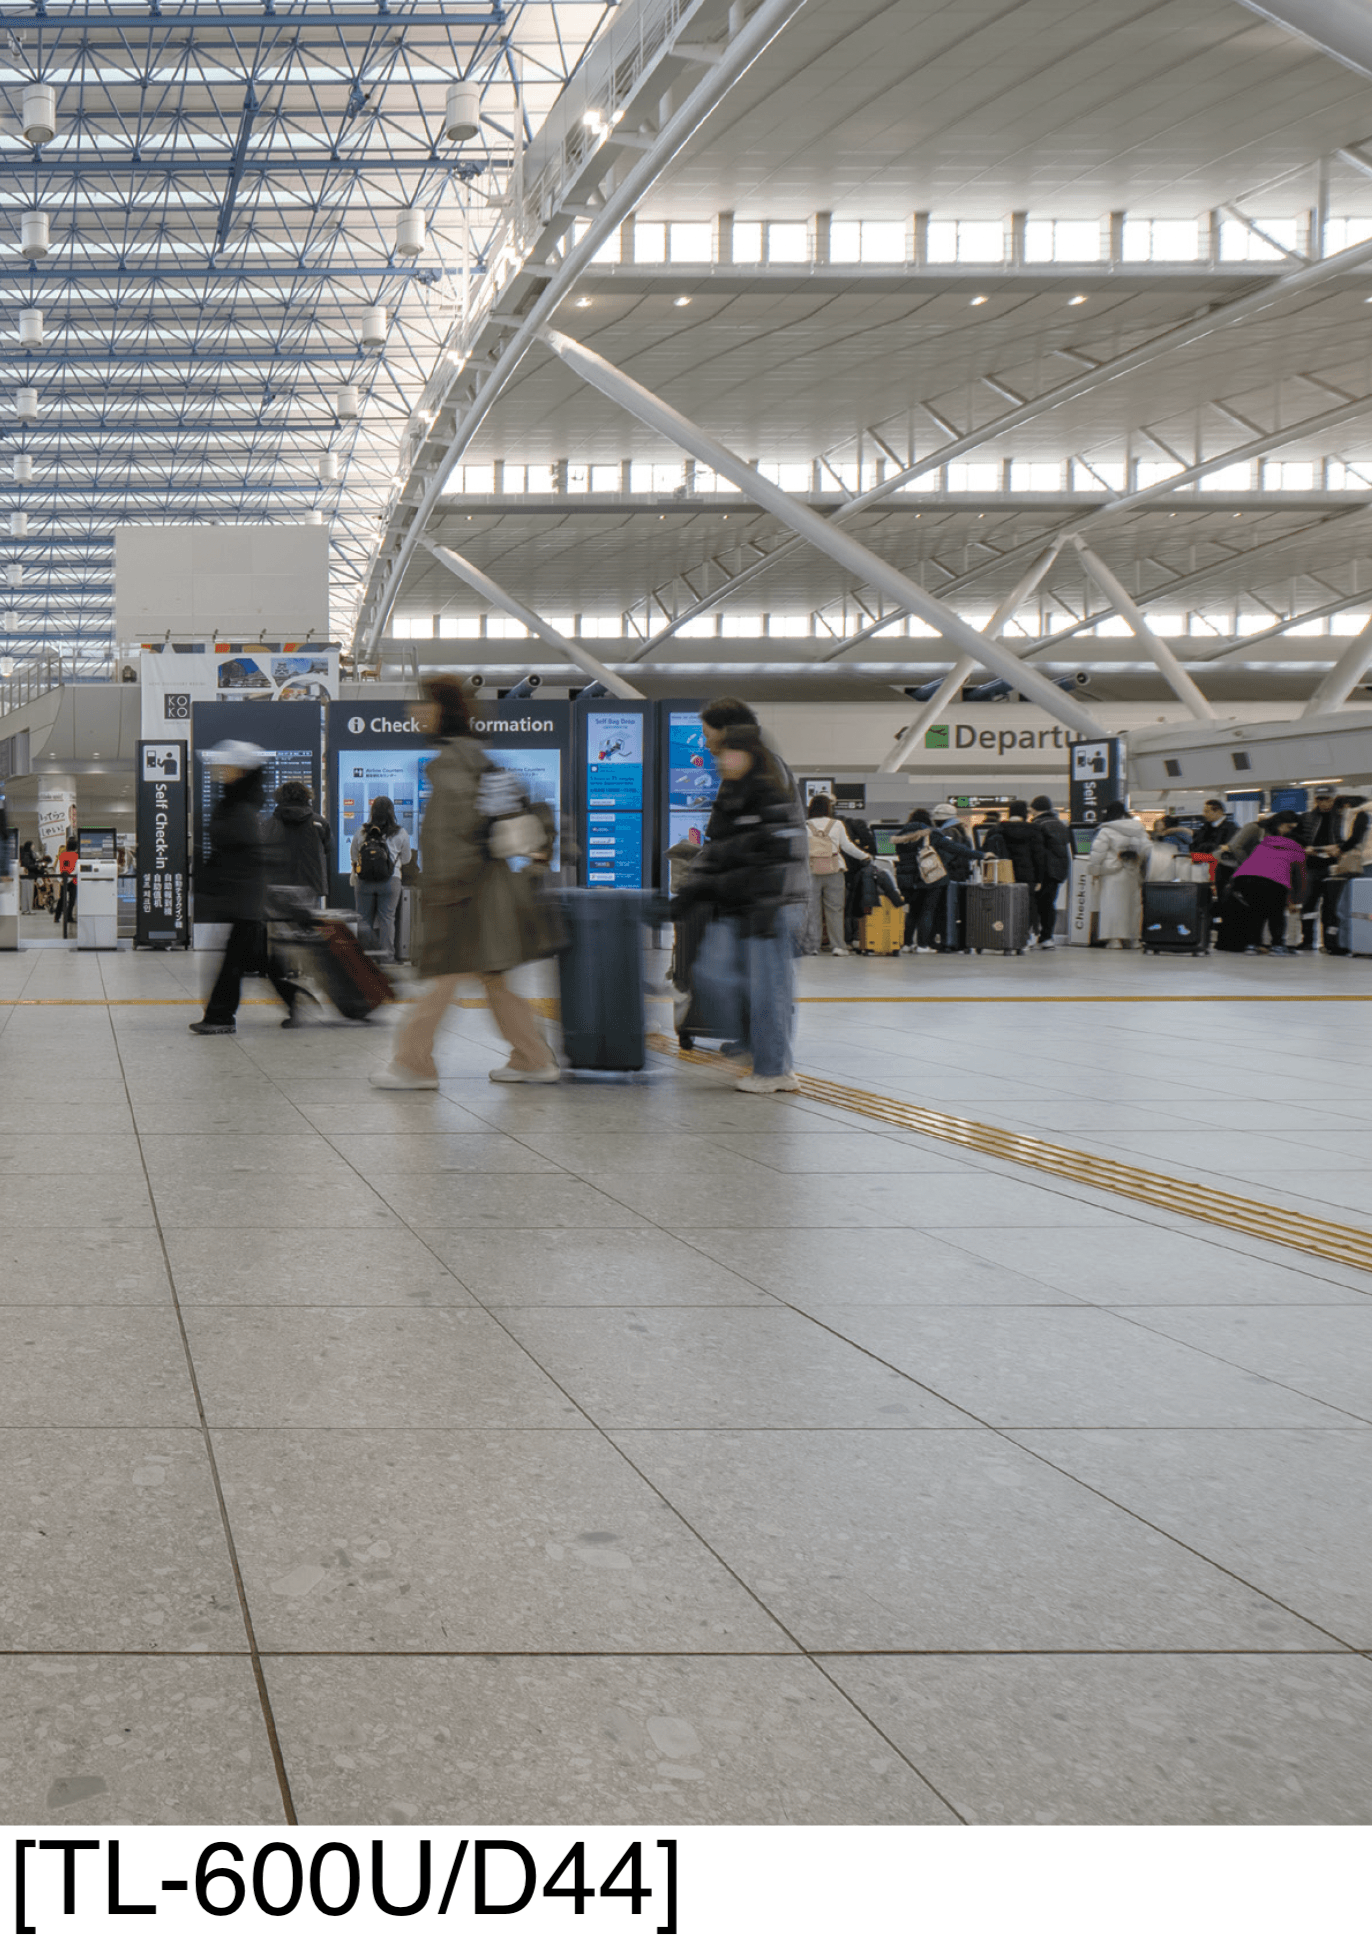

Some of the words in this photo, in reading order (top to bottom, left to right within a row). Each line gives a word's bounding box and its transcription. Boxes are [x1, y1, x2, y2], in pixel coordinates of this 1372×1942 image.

[370, 716, 428, 733] Check-
[469, 716, 554, 733] formation
[955, 724, 1084, 753] Departu
[155, 783, 169, 810] Self
[1083, 781, 1098, 807] Self
[155, 812, 169, 870] Check-in
[1075, 874, 1086, 930] Check-in
